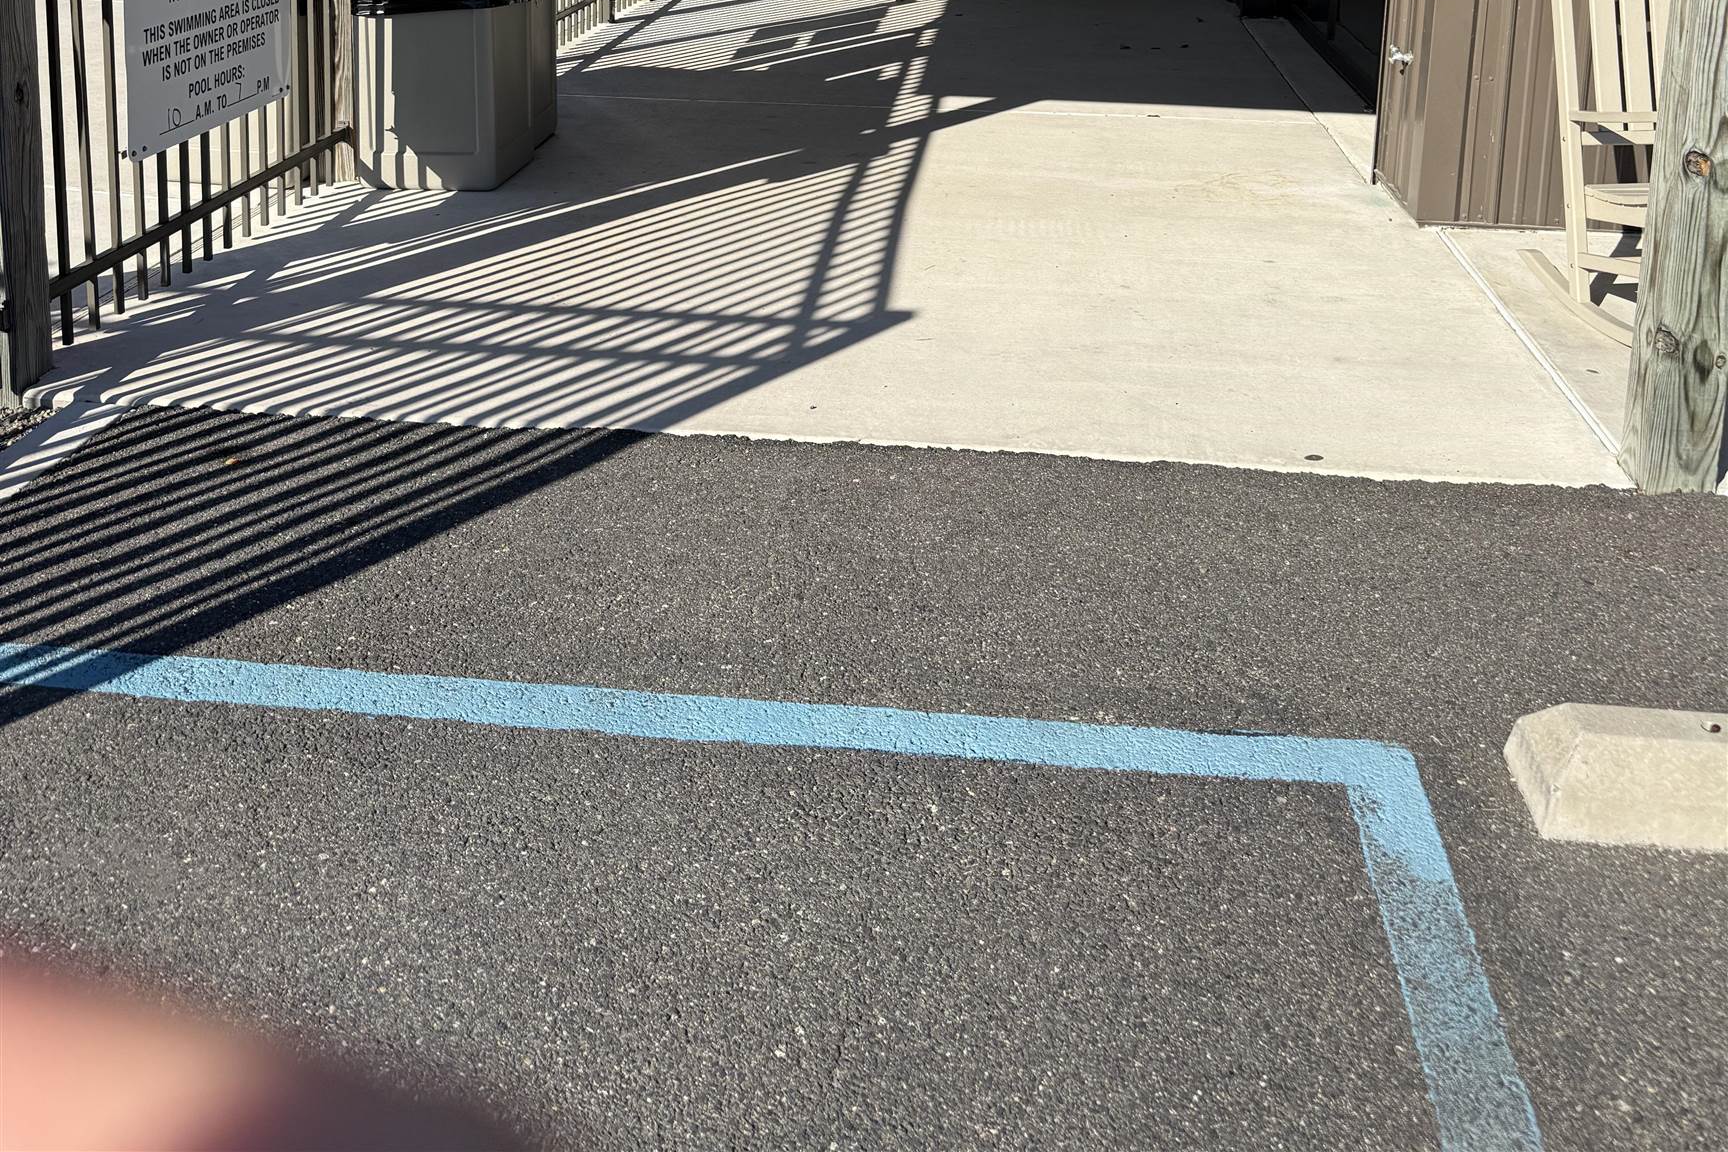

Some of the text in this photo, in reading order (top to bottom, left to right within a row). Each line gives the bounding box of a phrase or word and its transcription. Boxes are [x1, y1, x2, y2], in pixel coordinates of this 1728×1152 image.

[142, 9, 280, 67] WHEN THE OWNER OR OPERATOR
[144, 24, 166, 44] THIS
[168, 9, 217, 37] SWIMMING
[219, 2, 240, 21] AREA
[242, 0, 250, 14] IS
[162, 32, 266, 81] IS NOT ON THE PREMISES
[188, 64, 245, 98] POOL HOURS:
[167, 107, 182, 129] 10
[195, 100, 214, 120] A.M.
[217, 94, 227, 110] TO
